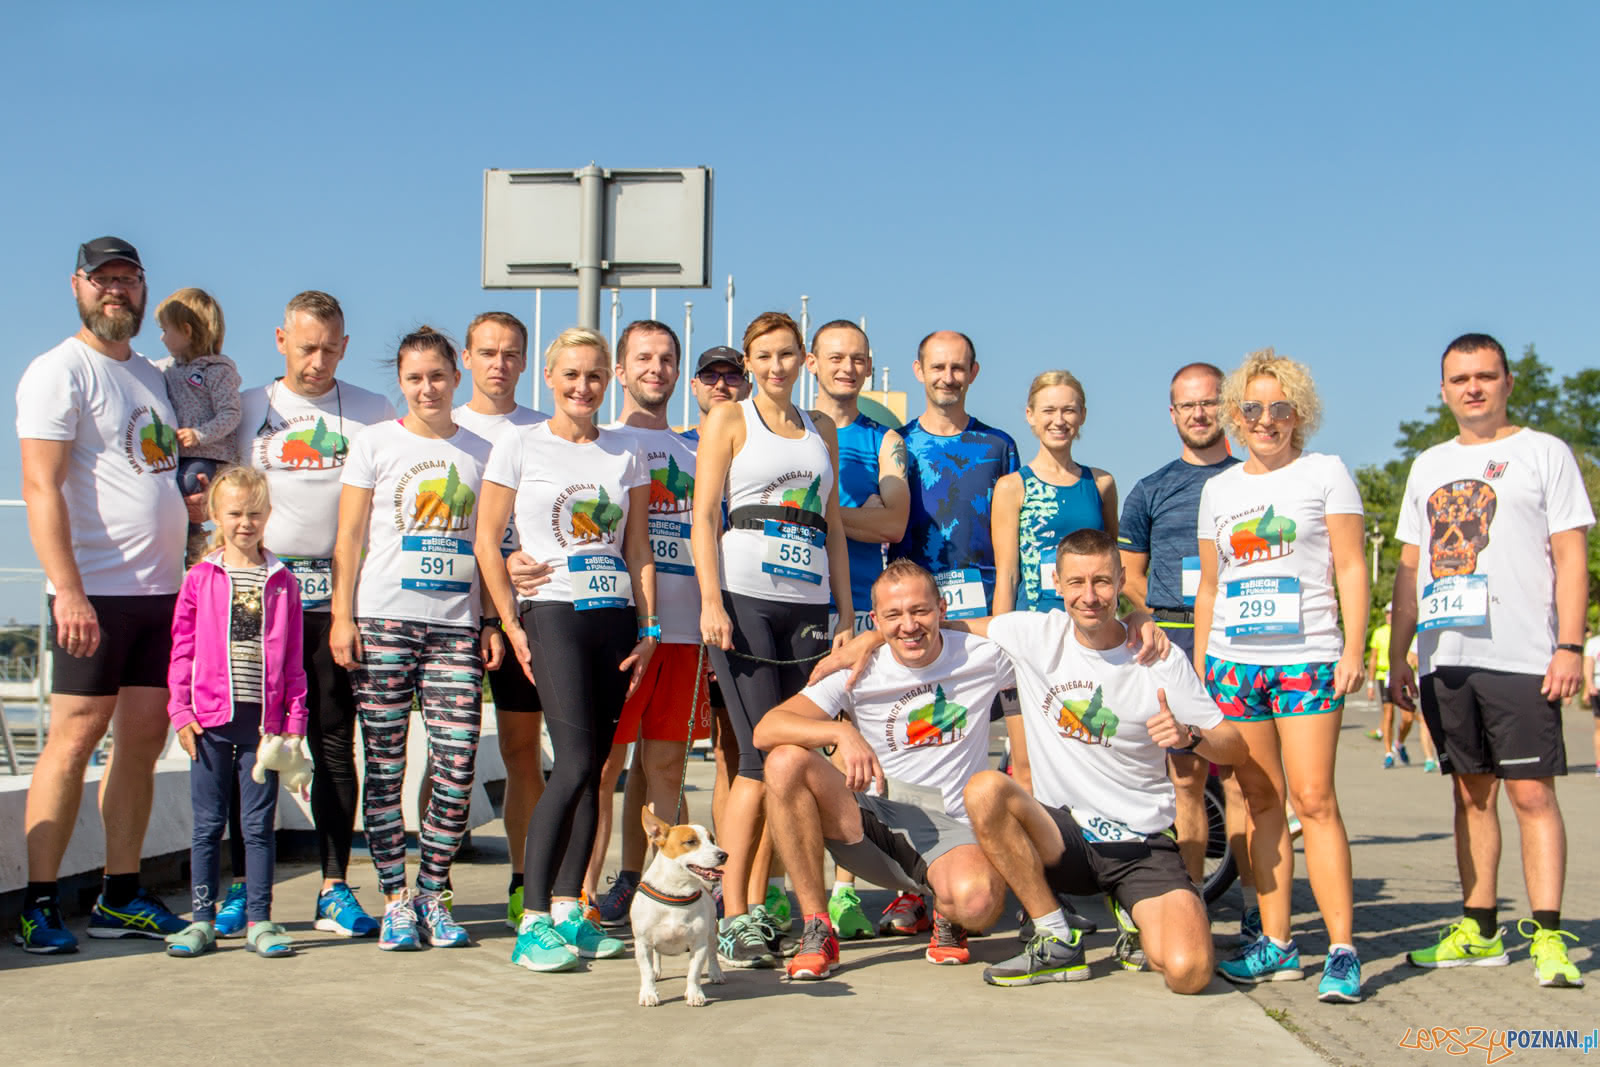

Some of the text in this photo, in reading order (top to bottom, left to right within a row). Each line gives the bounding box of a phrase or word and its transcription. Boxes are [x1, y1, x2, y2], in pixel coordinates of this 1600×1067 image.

[777, 470, 813, 485] BIEGAJĄ
[394, 459, 448, 532] NARAMOWICE BIEGAJĄ
[552, 482, 597, 549] NARAMOWICE BIEGAJĄ
[780, 543, 812, 566] 553
[420, 556, 454, 576] 591
[588, 575, 617, 593] 487
[943, 588, 964, 607] 01
[1429, 595, 1464, 614] 314
[1239, 599, 1276, 619] 299
[855, 614, 874, 632] 70
[1060, 680, 1093, 692] BIEGAJĄ
[885, 683, 934, 753] ARAMOWICE BIEGAJĄ
